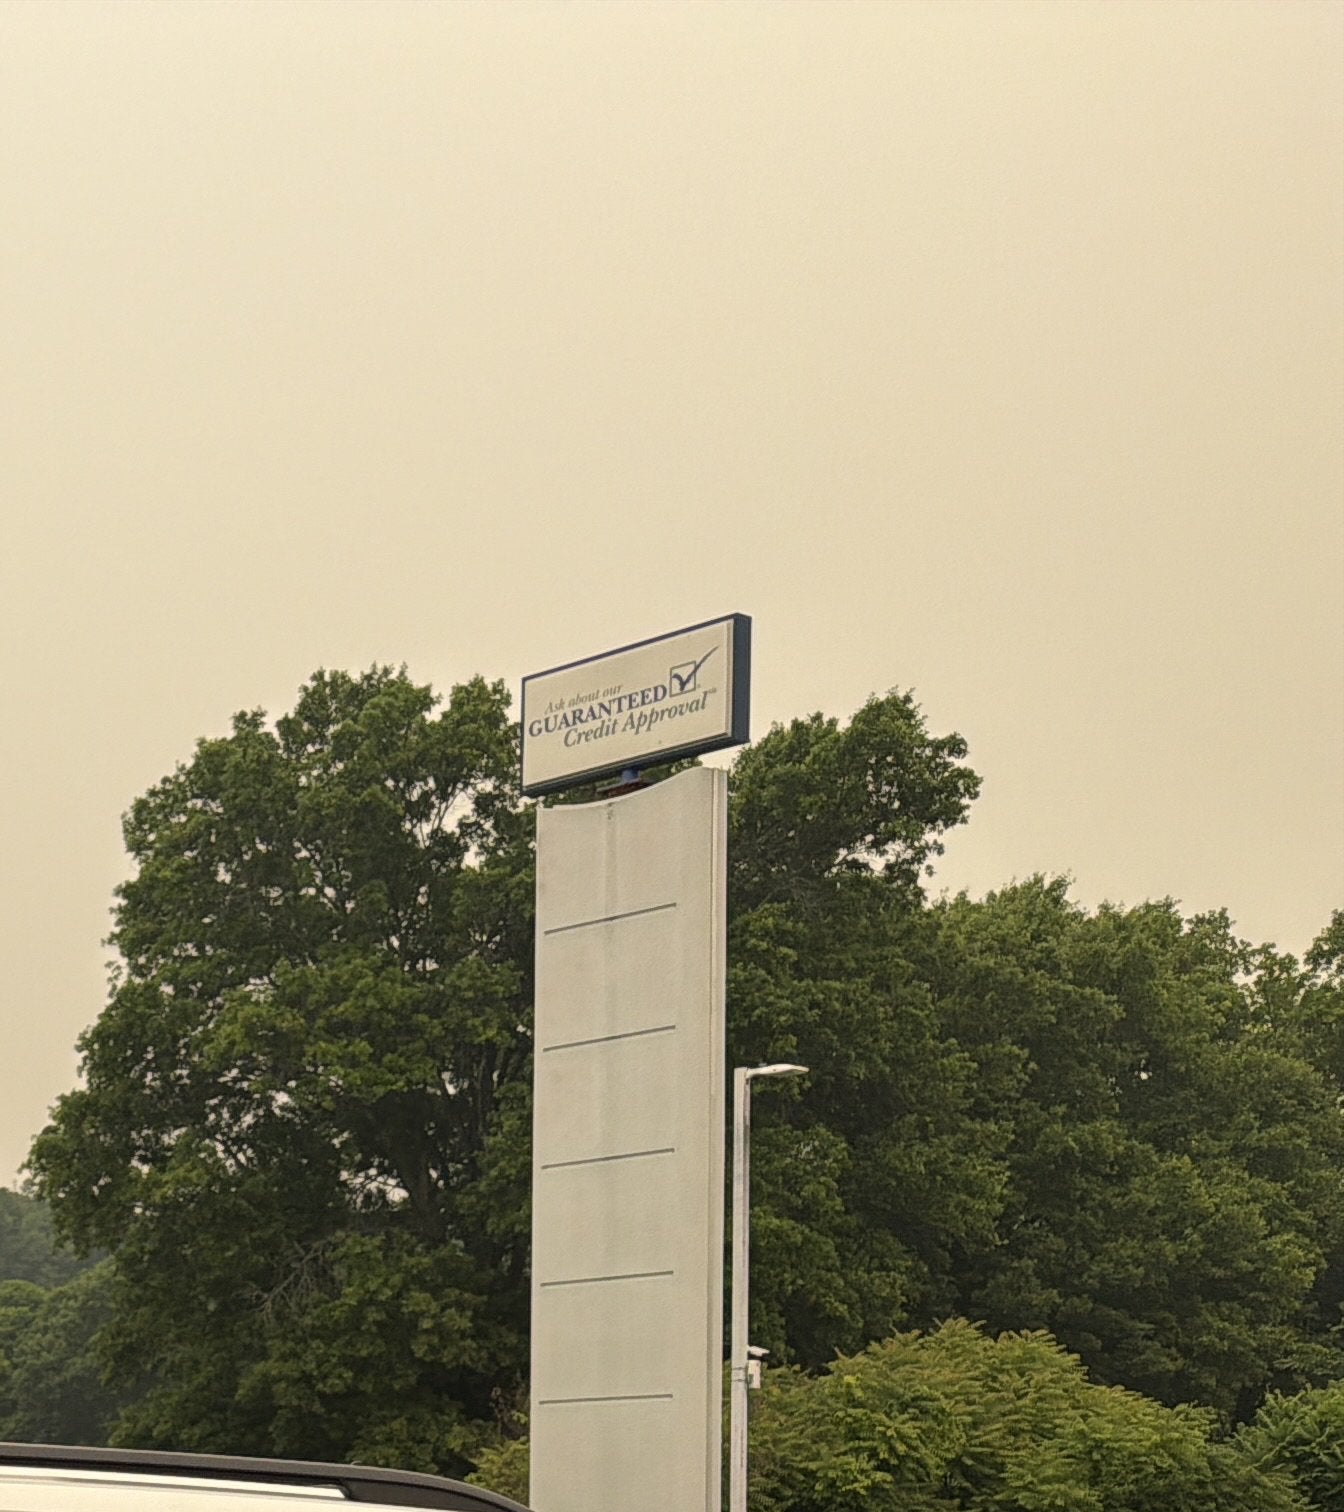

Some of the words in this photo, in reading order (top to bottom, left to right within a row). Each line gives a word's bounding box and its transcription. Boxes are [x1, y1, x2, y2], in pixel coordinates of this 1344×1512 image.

[528, 684, 668, 737] GUARANTEED
[545, 698, 566, 715] Ask
[568, 689, 600, 708] about
[602, 684, 623, 698] our
[563, 717, 618, 748] Credit
[621, 690, 710, 735] Approval
